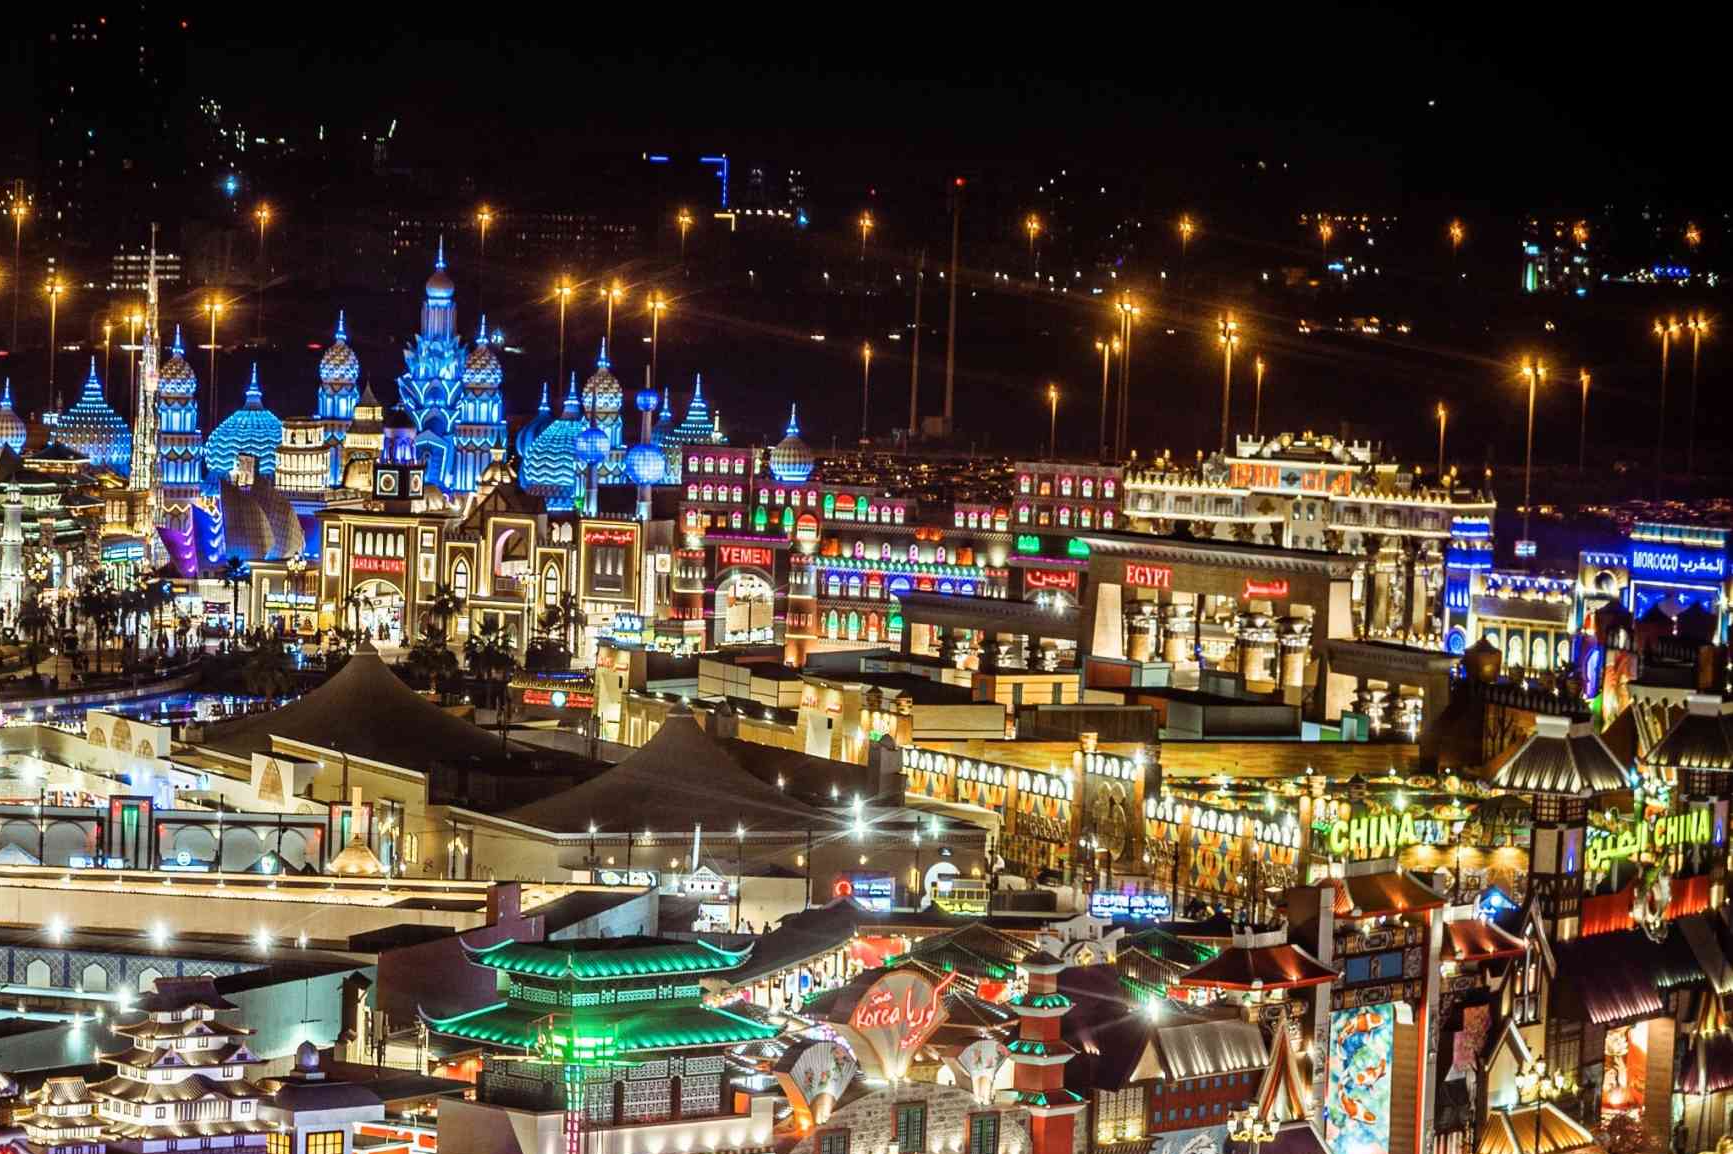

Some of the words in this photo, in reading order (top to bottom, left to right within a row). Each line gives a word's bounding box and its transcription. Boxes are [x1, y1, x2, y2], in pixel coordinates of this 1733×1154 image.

[720, 546, 772, 565] YEMEN
[1633, 551, 1678, 571] MOROCCO
[1026, 570, 1077, 588] اليمن
[1126, 564, 1171, 587] EGYPT
[1328, 812, 1419, 853] CHINA
[1653, 808, 1710, 846] CHINA
[856, 1005, 900, 1029] Korea
